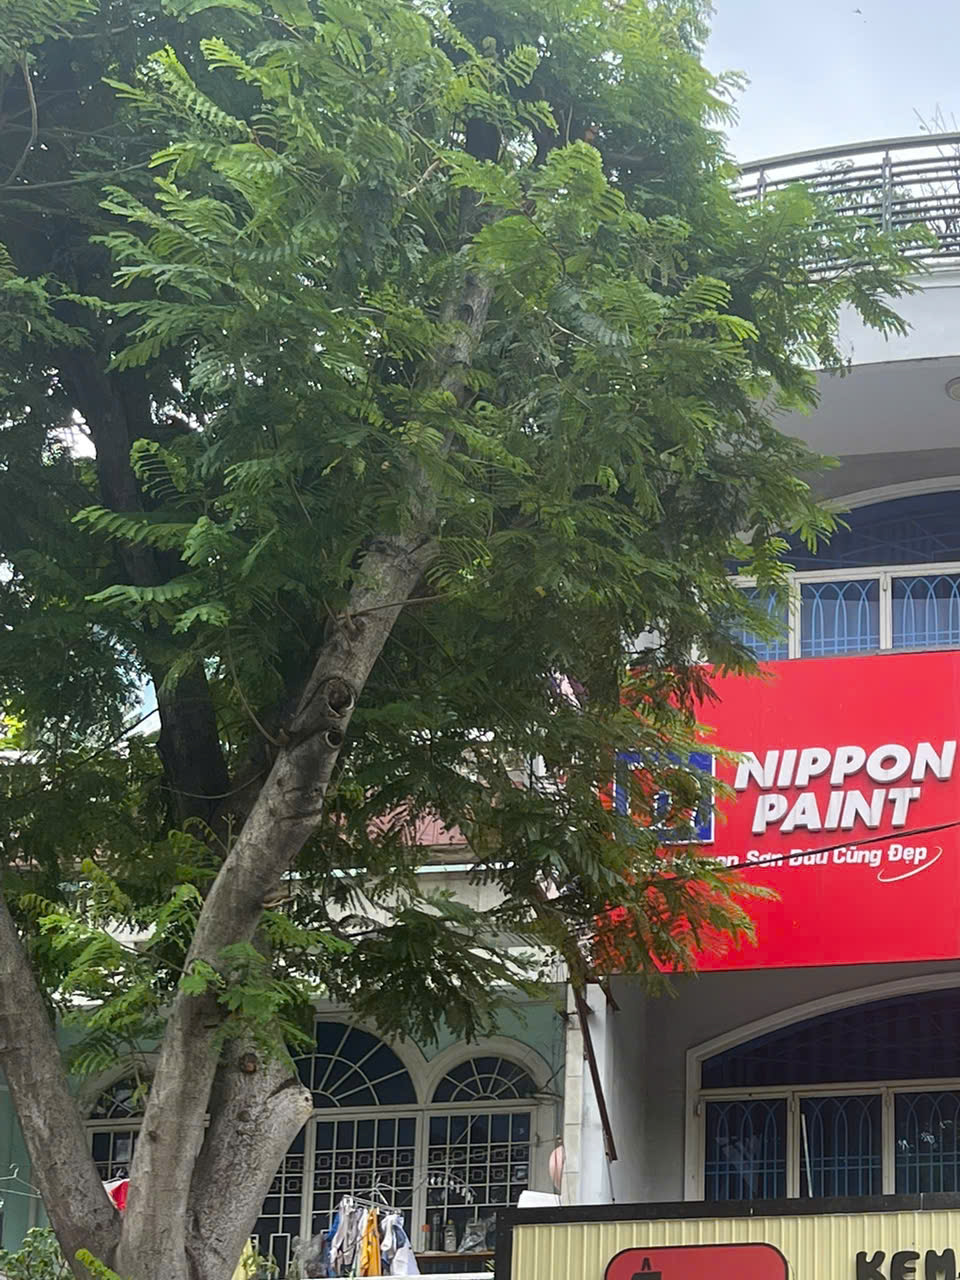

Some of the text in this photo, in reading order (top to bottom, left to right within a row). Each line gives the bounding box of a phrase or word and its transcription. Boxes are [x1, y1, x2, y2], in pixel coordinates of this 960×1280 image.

[734, 740, 956, 790] NIPPON
[752, 787, 921, 834] PAINT
[832, 845, 882, 868] Cũng
[887, 843, 928, 865] Đẹp
